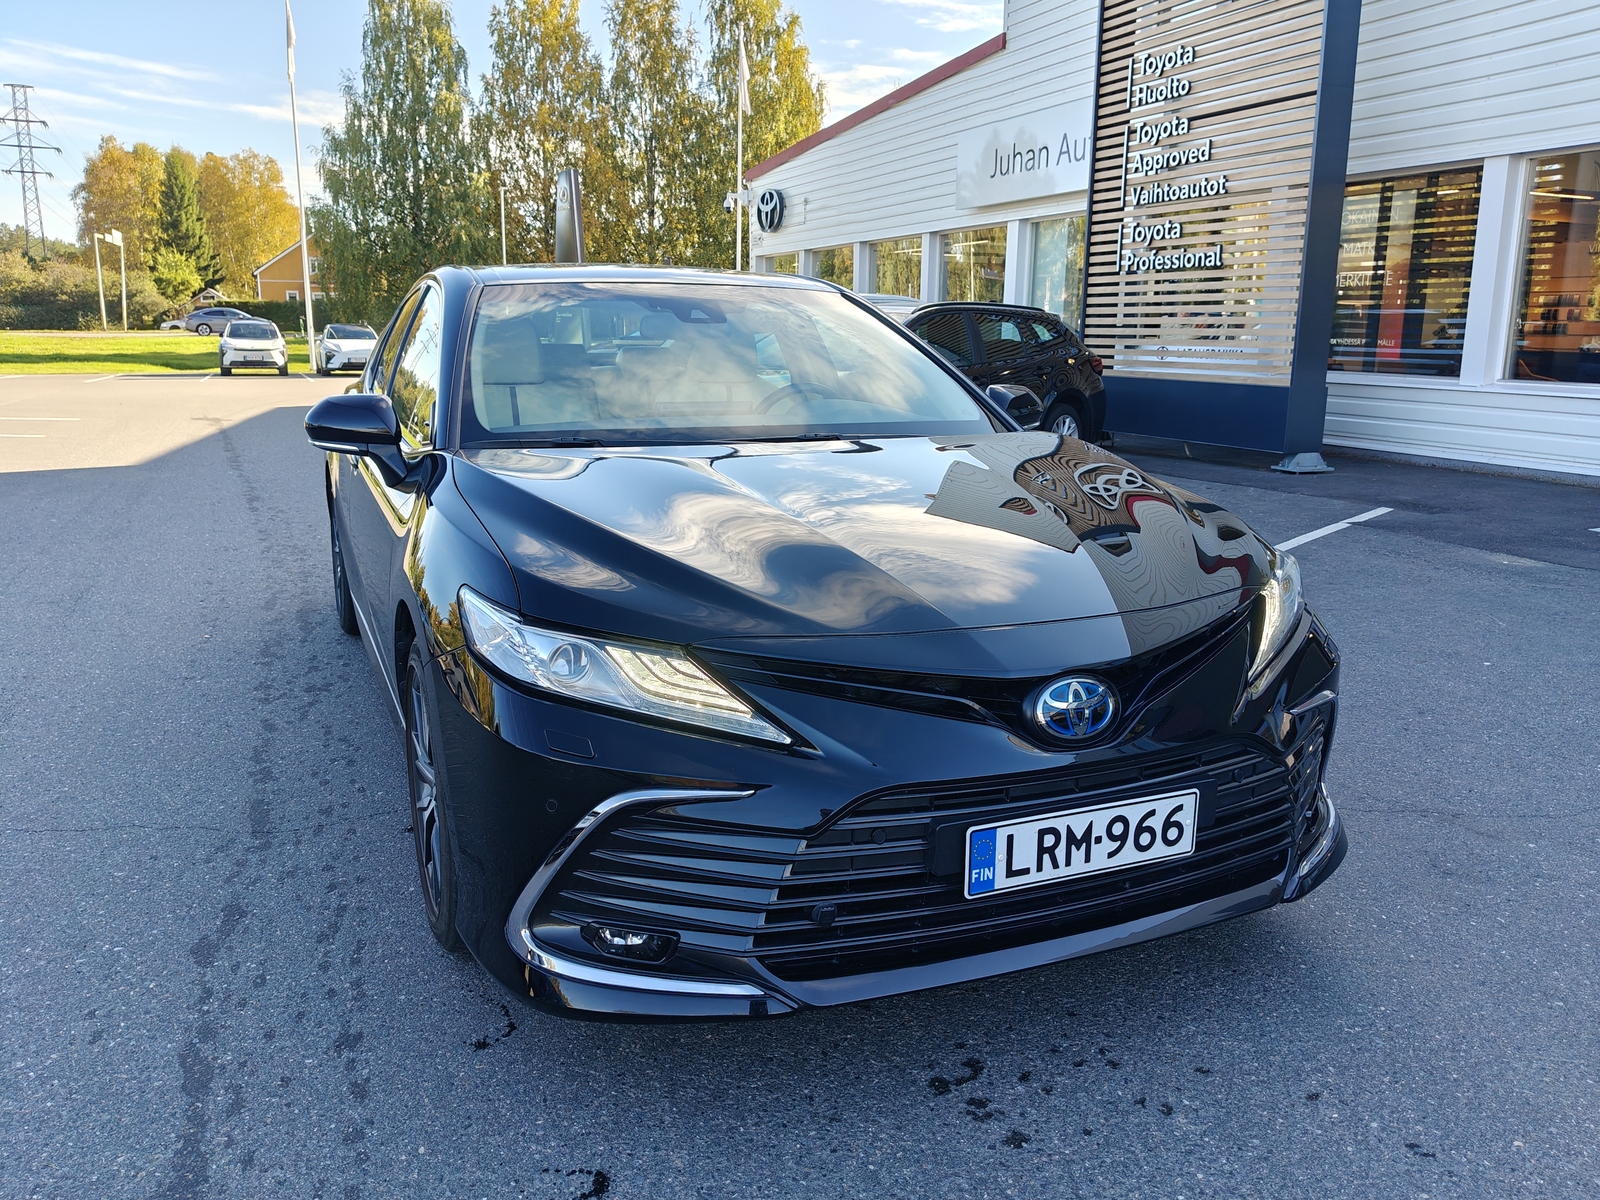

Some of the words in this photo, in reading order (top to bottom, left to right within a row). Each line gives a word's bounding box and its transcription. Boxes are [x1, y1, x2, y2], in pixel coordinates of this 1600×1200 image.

[1138, 44, 1195, 78] Toyota
[1135, 77, 1191, 106] Huolto
[1134, 116, 1190, 145] Toyota
[990, 142, 1050, 179] Juhan
[1131, 138, 1213, 173] Approved
[1130, 174, 1227, 206] Vaihtoautot
[1128, 219, 1182, 246] Toyota
[1125, 244, 1223, 272] Professional
[1005, 803, 1185, 879] LRM-966
[971, 866, 994, 883] FIN
